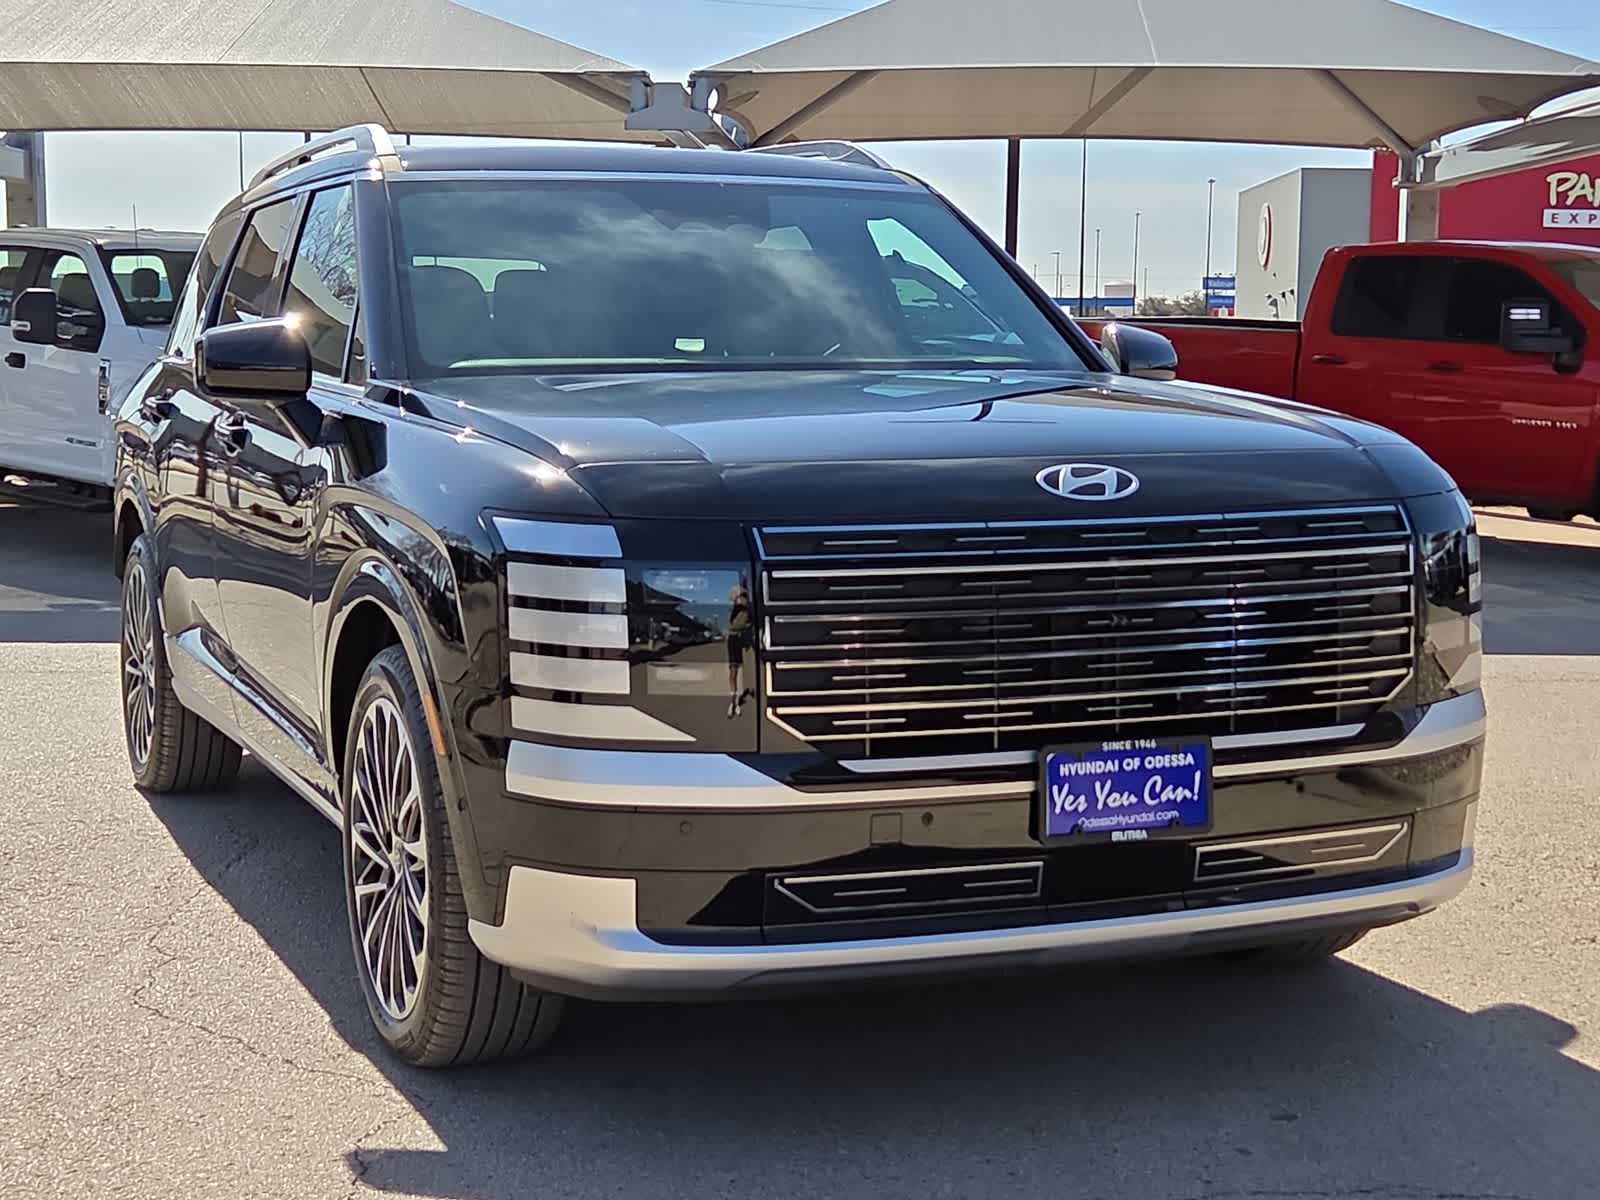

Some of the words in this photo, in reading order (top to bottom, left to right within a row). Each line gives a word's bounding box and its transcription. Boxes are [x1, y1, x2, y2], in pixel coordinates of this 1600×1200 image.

[1059, 759, 1119, 777] HYUNDAI
[1122, 757, 1141, 771] OF
[1144, 753, 1195, 769] ODESSA
[1052, 783, 1088, 815] Yes
[1094, 779, 1139, 810] You
[1143, 770, 1201, 806] Can!
